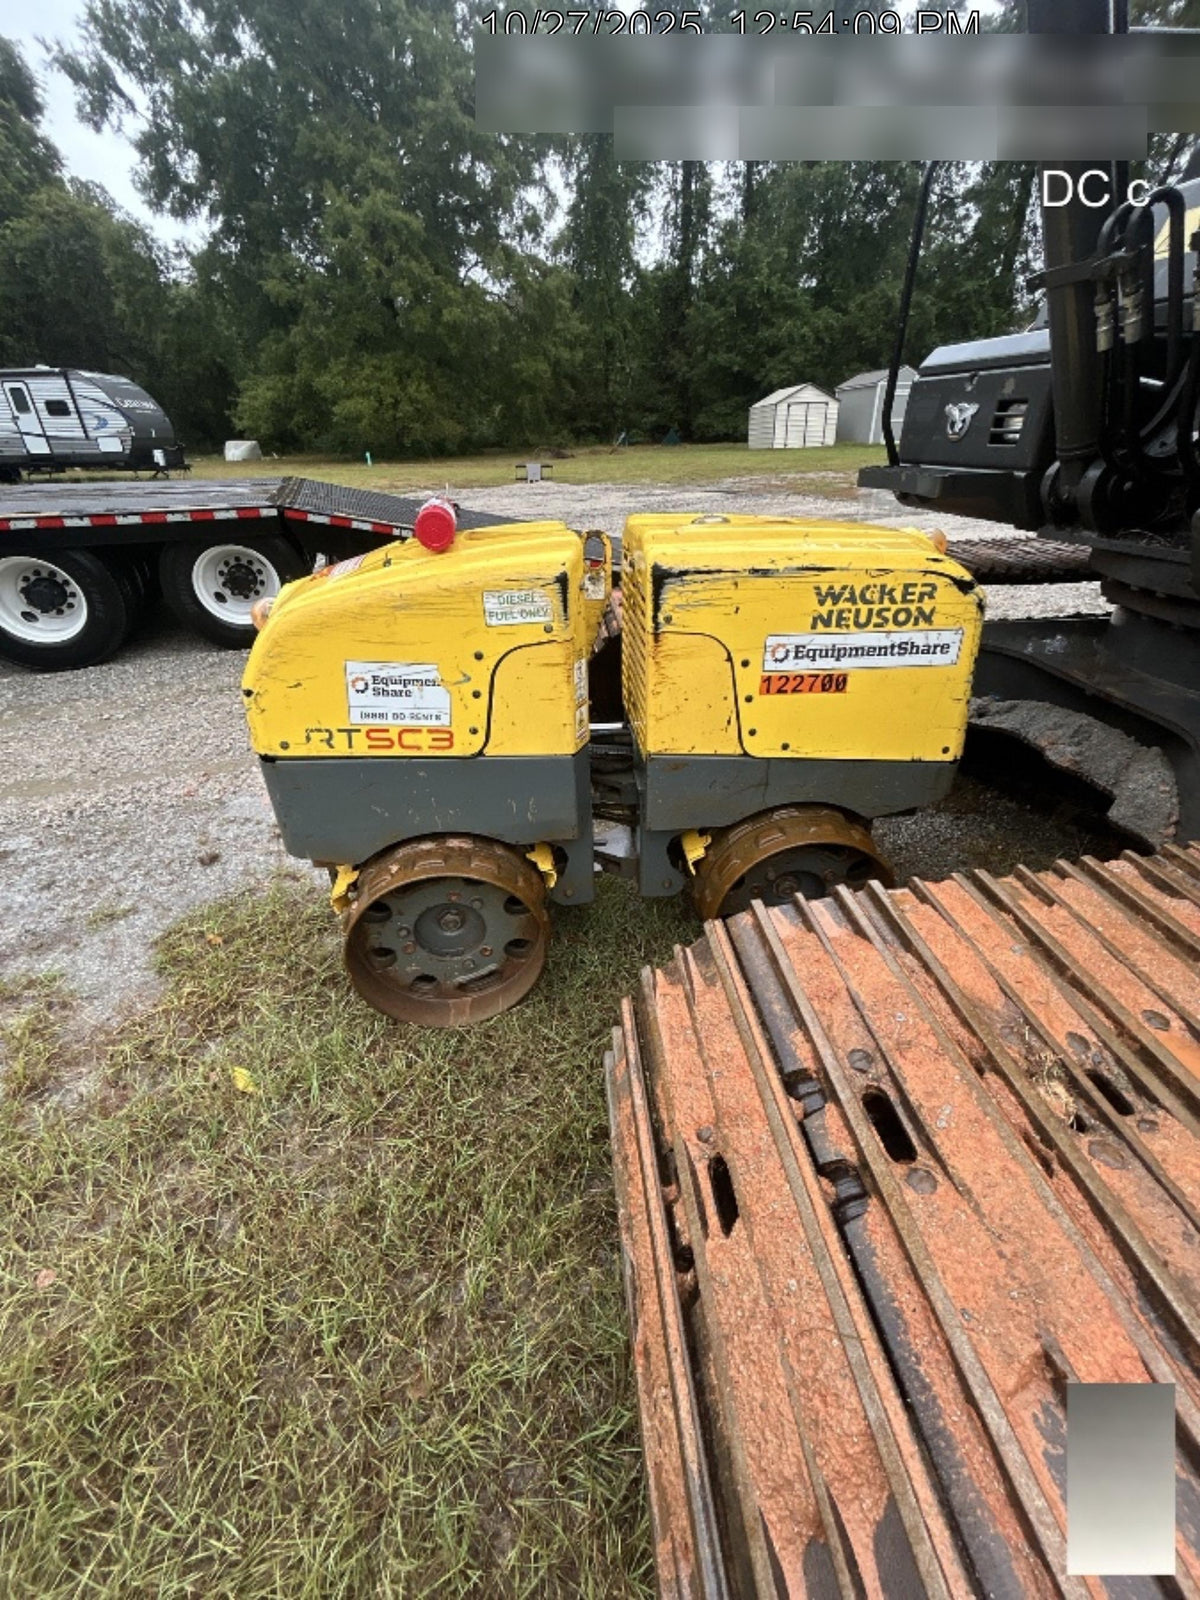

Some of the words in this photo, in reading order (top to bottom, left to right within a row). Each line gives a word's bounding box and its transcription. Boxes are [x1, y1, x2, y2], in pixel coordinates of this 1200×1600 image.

[497, 592, 538, 605] DIESEL
[813, 583, 938, 607] WACKER
[488, 609, 518, 621] FUEL
[520, 607, 549, 619] ONLY
[811, 606, 936, 630] NEUSON
[793, 641, 950, 663] EquipmentShare
[371, 675, 443, 689] Equipmen
[761, 673, 848, 694] 122700
[372, 686, 413, 698] Share
